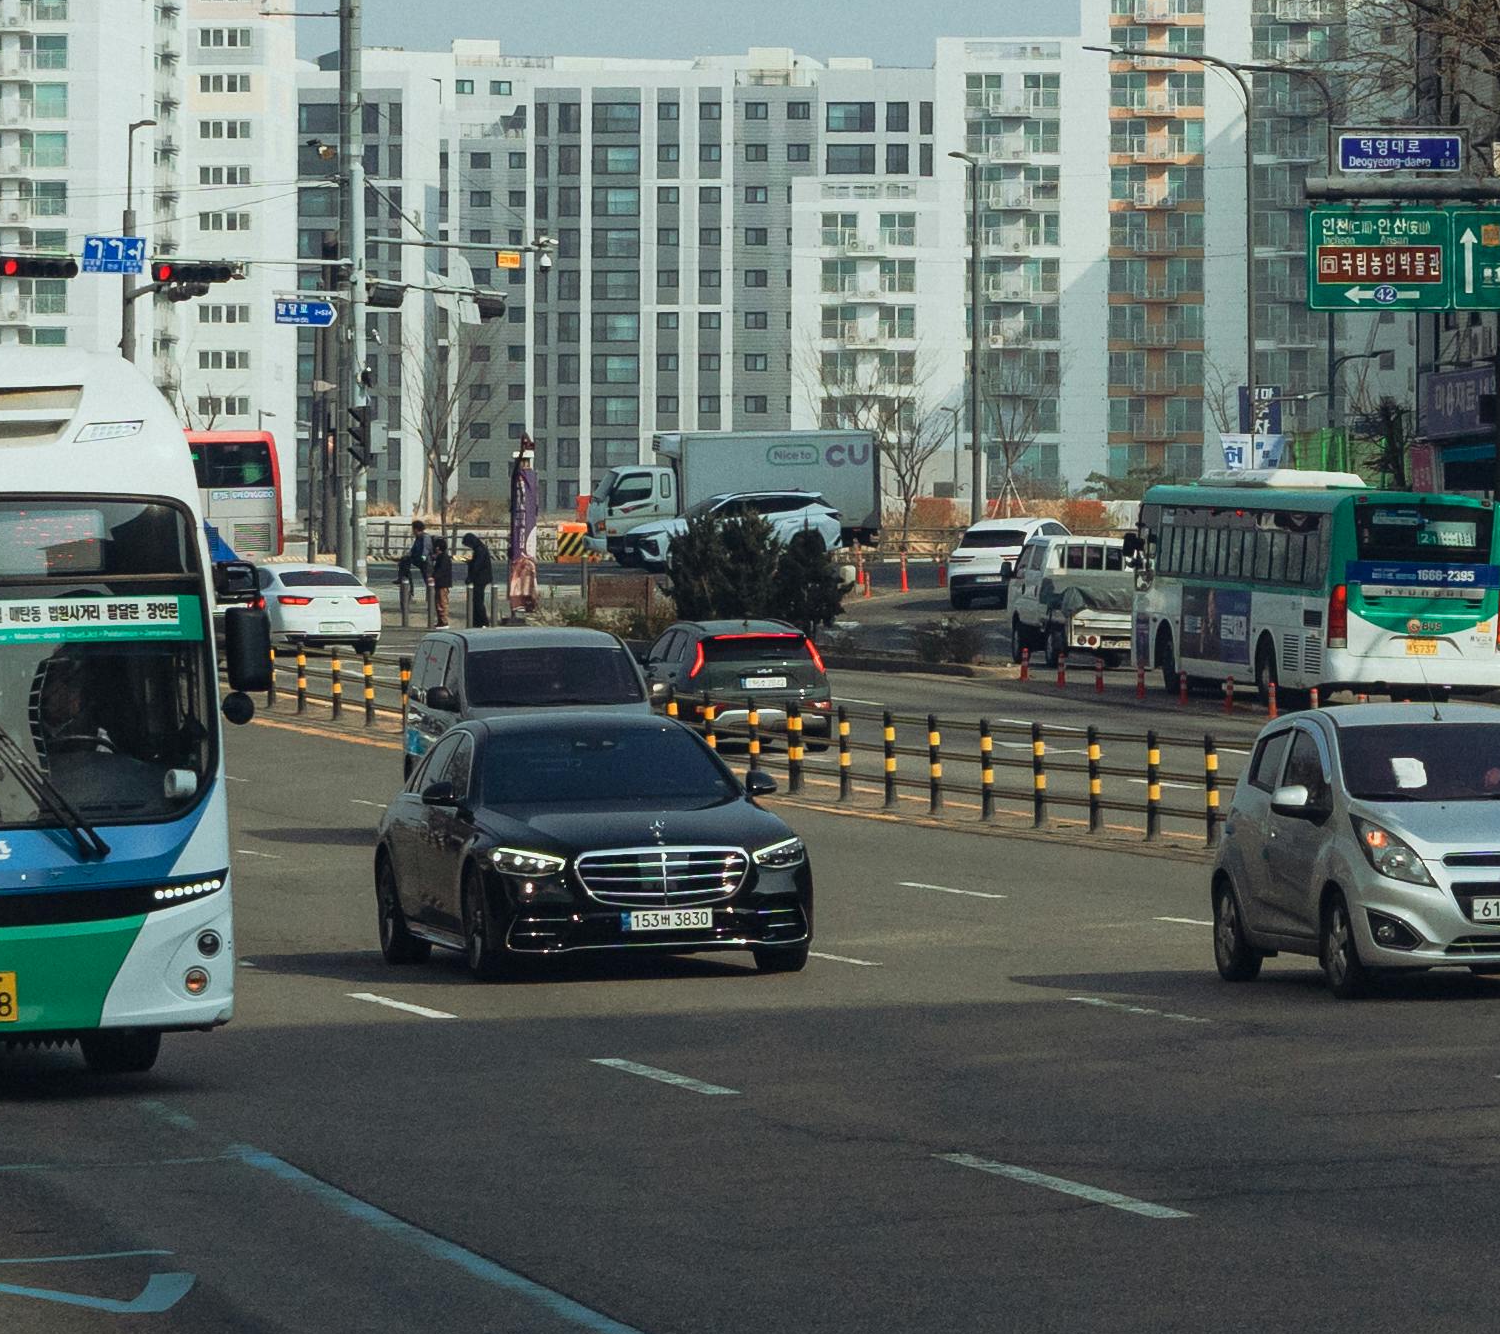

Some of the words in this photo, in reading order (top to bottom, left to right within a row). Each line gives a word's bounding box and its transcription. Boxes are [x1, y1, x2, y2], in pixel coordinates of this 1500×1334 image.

[1361, 139, 1421, 156] 덕영대로
[1349, 156, 1431, 169] Deogyeong-daero
[1341, 252, 1439, 276] 국립농업박물관
[1376, 288, 1394, 300] 42
[774, 450, 799, 460] Nice
[800, 450, 812, 460] to
[825, 443, 869, 468] CU
[49, 604, 101, 622] 법원사거리
[147, 602, 179, 621] 장안문
[674, 911, 709, 927] 3830
